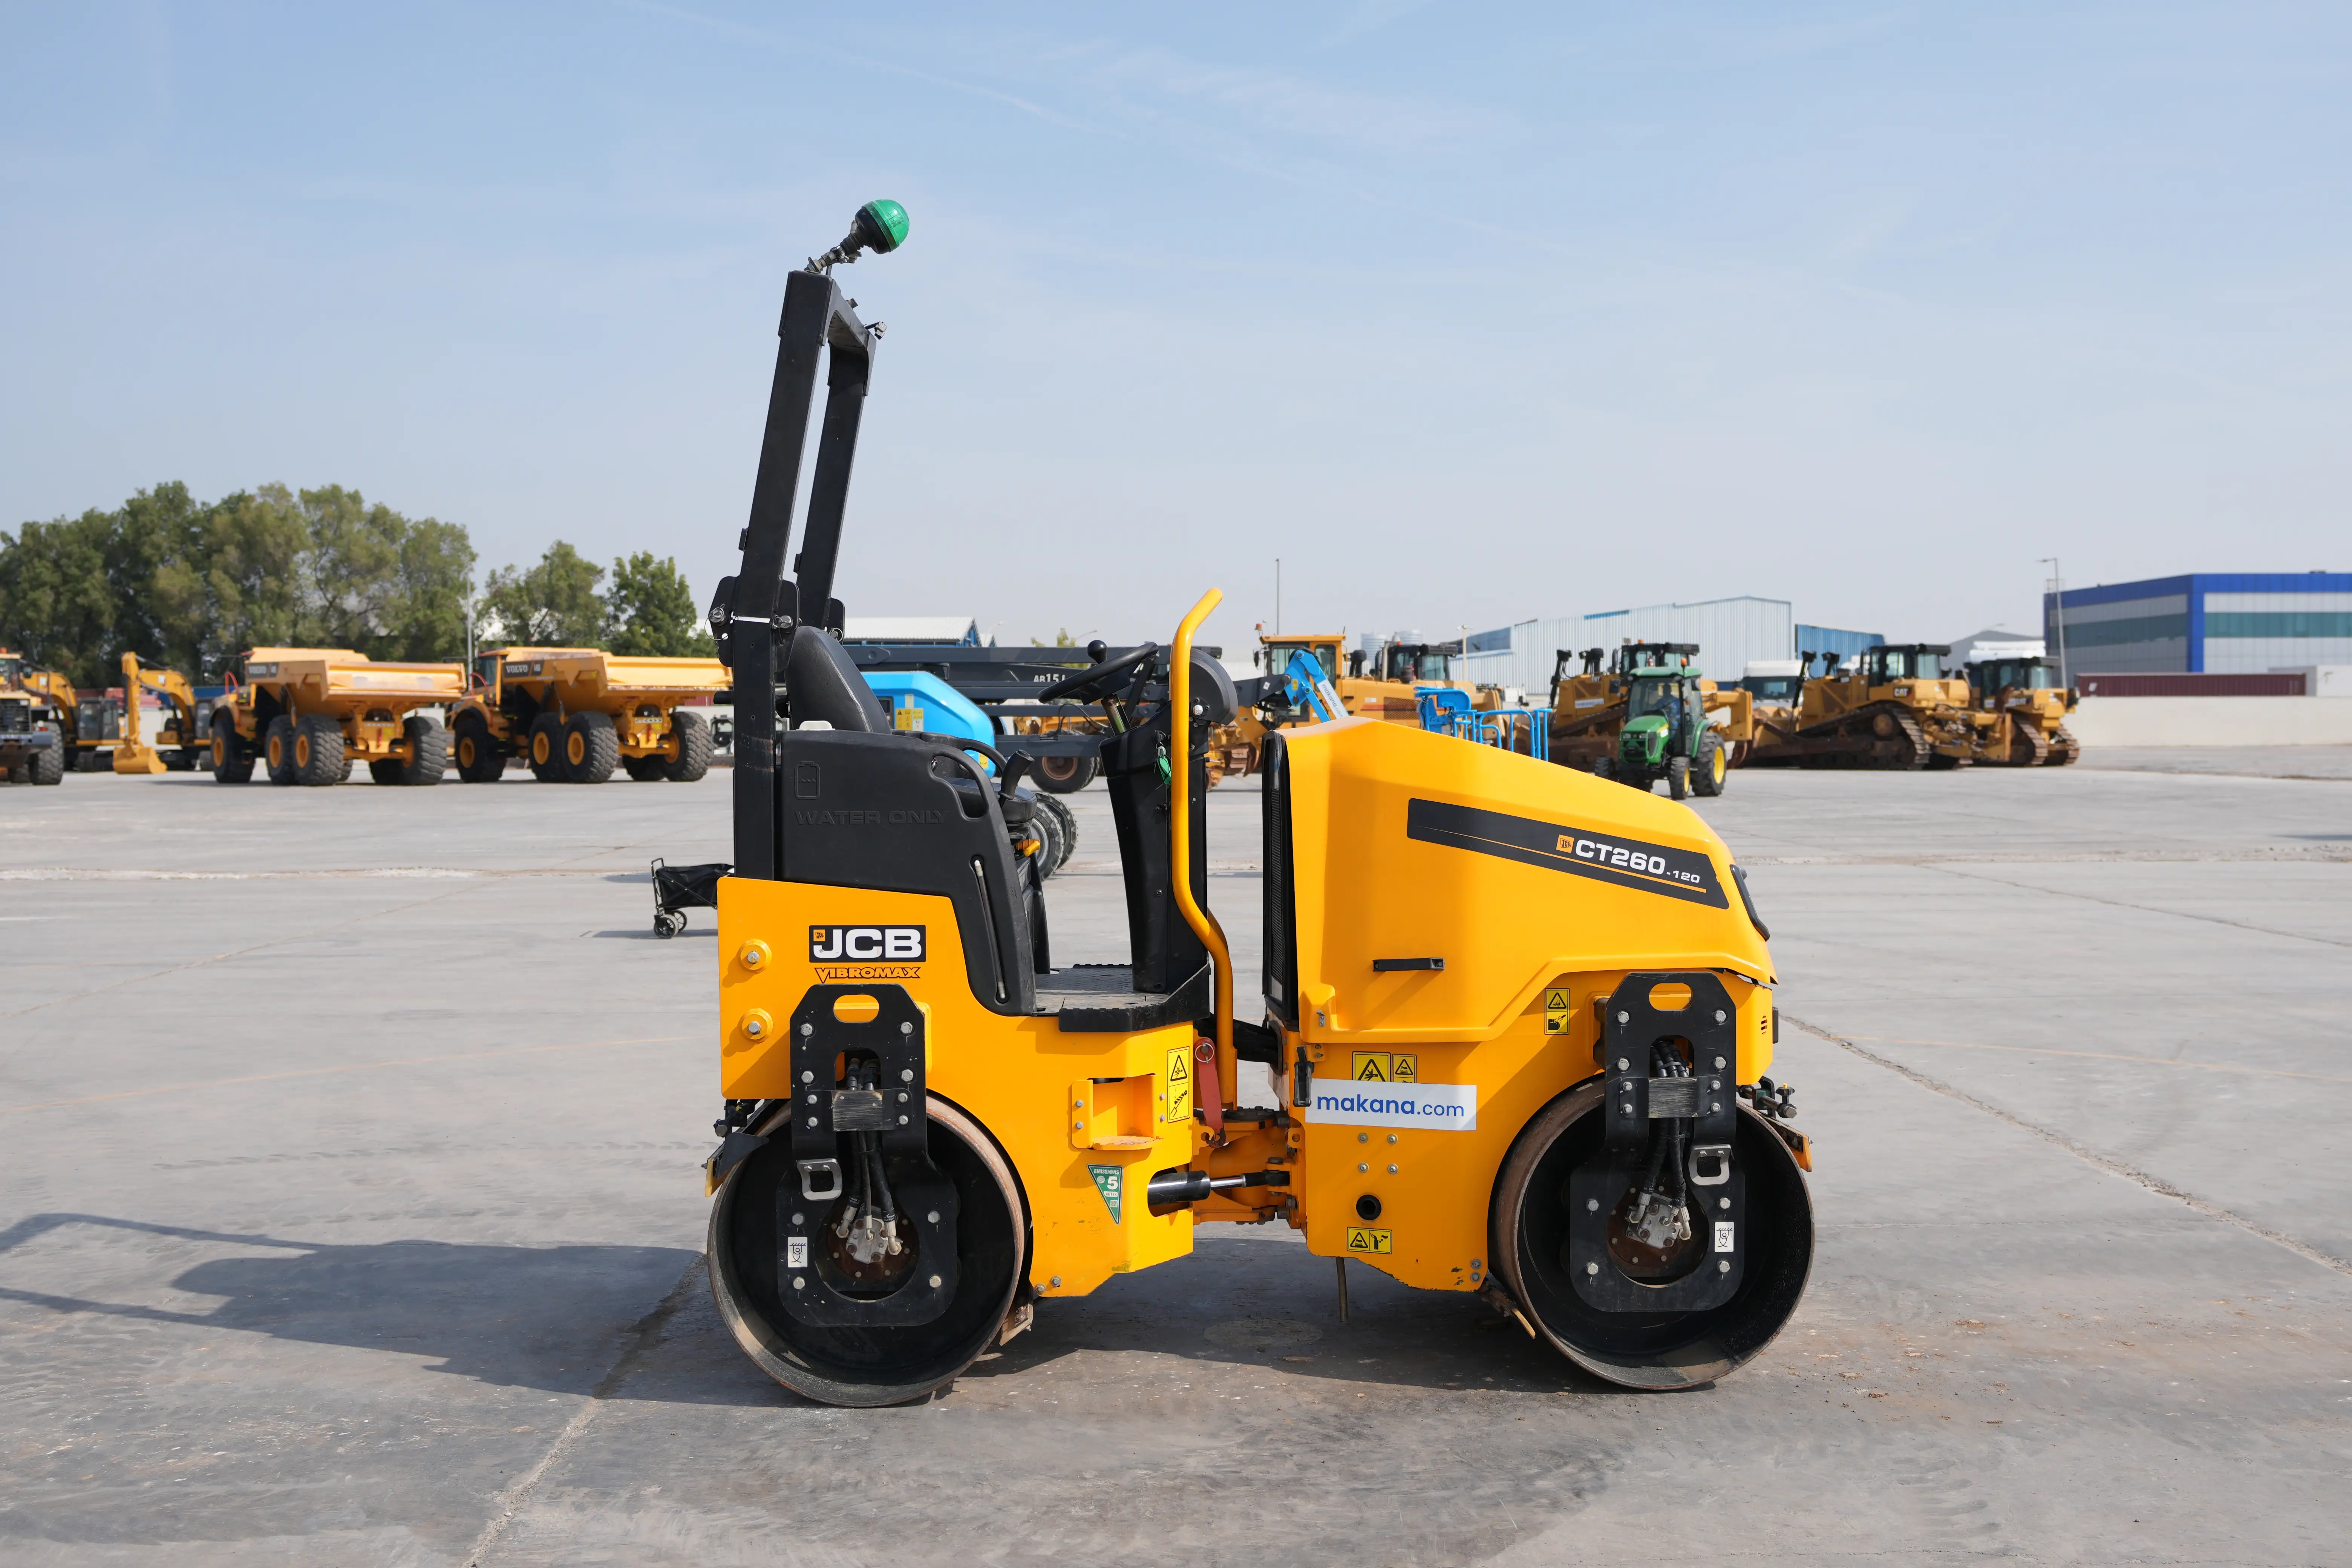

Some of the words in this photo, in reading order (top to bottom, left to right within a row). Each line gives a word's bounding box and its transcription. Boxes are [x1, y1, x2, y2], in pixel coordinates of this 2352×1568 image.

[506, 665, 528, 673] VOLVO
[1321, 683, 1343, 718] makana.com
[1894, 688, 1908, 697] CAT
[795, 810, 880, 825] WATER
[888, 810, 950, 824] ONLY
[813, 929, 922, 958] JCB
[814, 967, 921, 984] VIBROMAX
[1317, 1094, 1464, 1117] makana.com
[1107, 1176, 1118, 1190] 5
